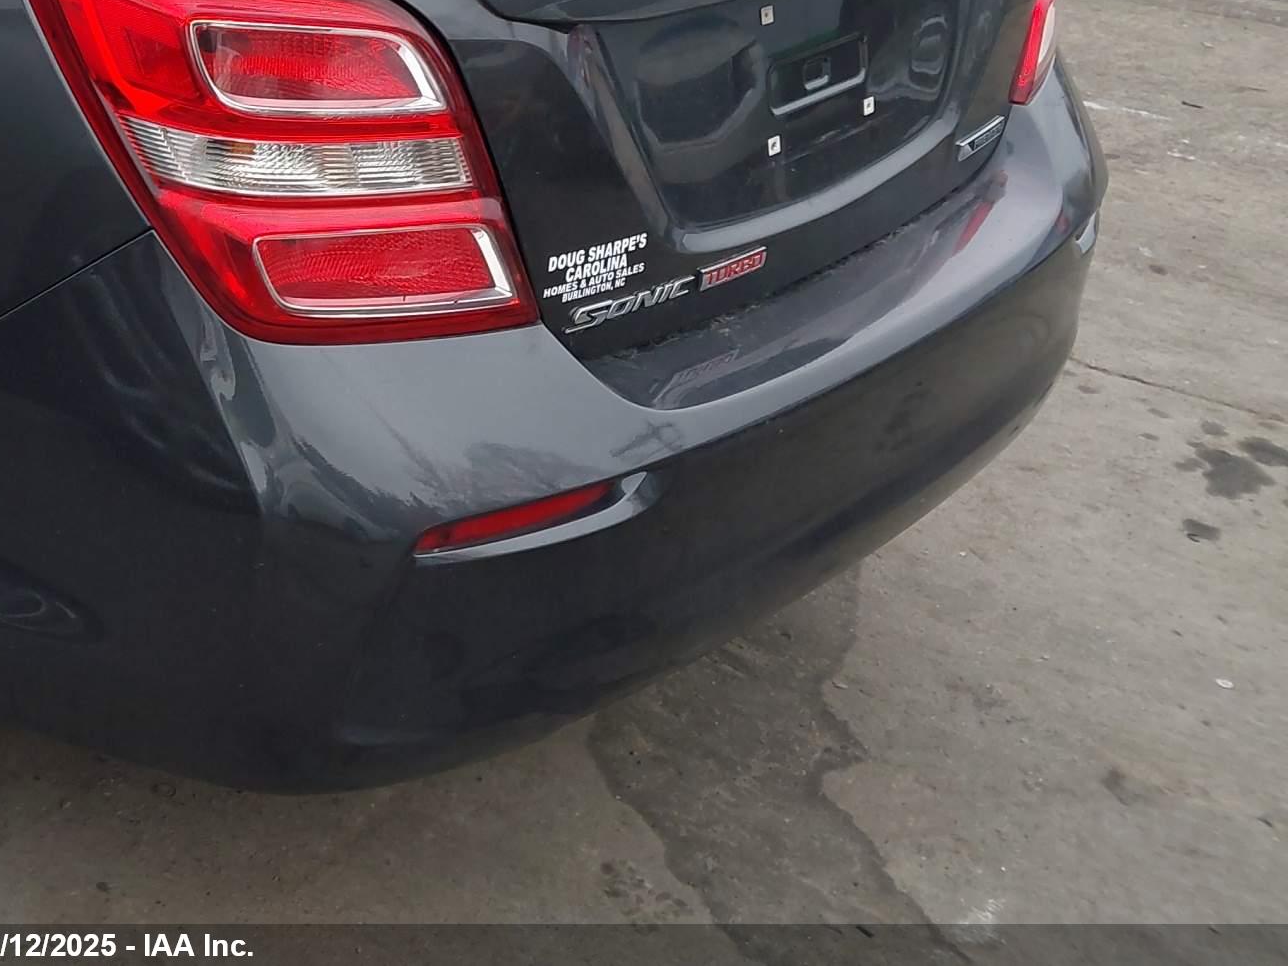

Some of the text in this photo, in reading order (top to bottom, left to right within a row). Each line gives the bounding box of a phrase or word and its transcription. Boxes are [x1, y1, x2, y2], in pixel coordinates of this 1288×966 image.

[548, 232, 648, 272] DOUG SHARPE'S
[565, 253, 628, 283] CAROLINA
[543, 262, 645, 298] HOMES & AUTO SALES
[561, 277, 626, 303] BURLINGTON, NC
[564, 252, 762, 334] SONIC TURBO
